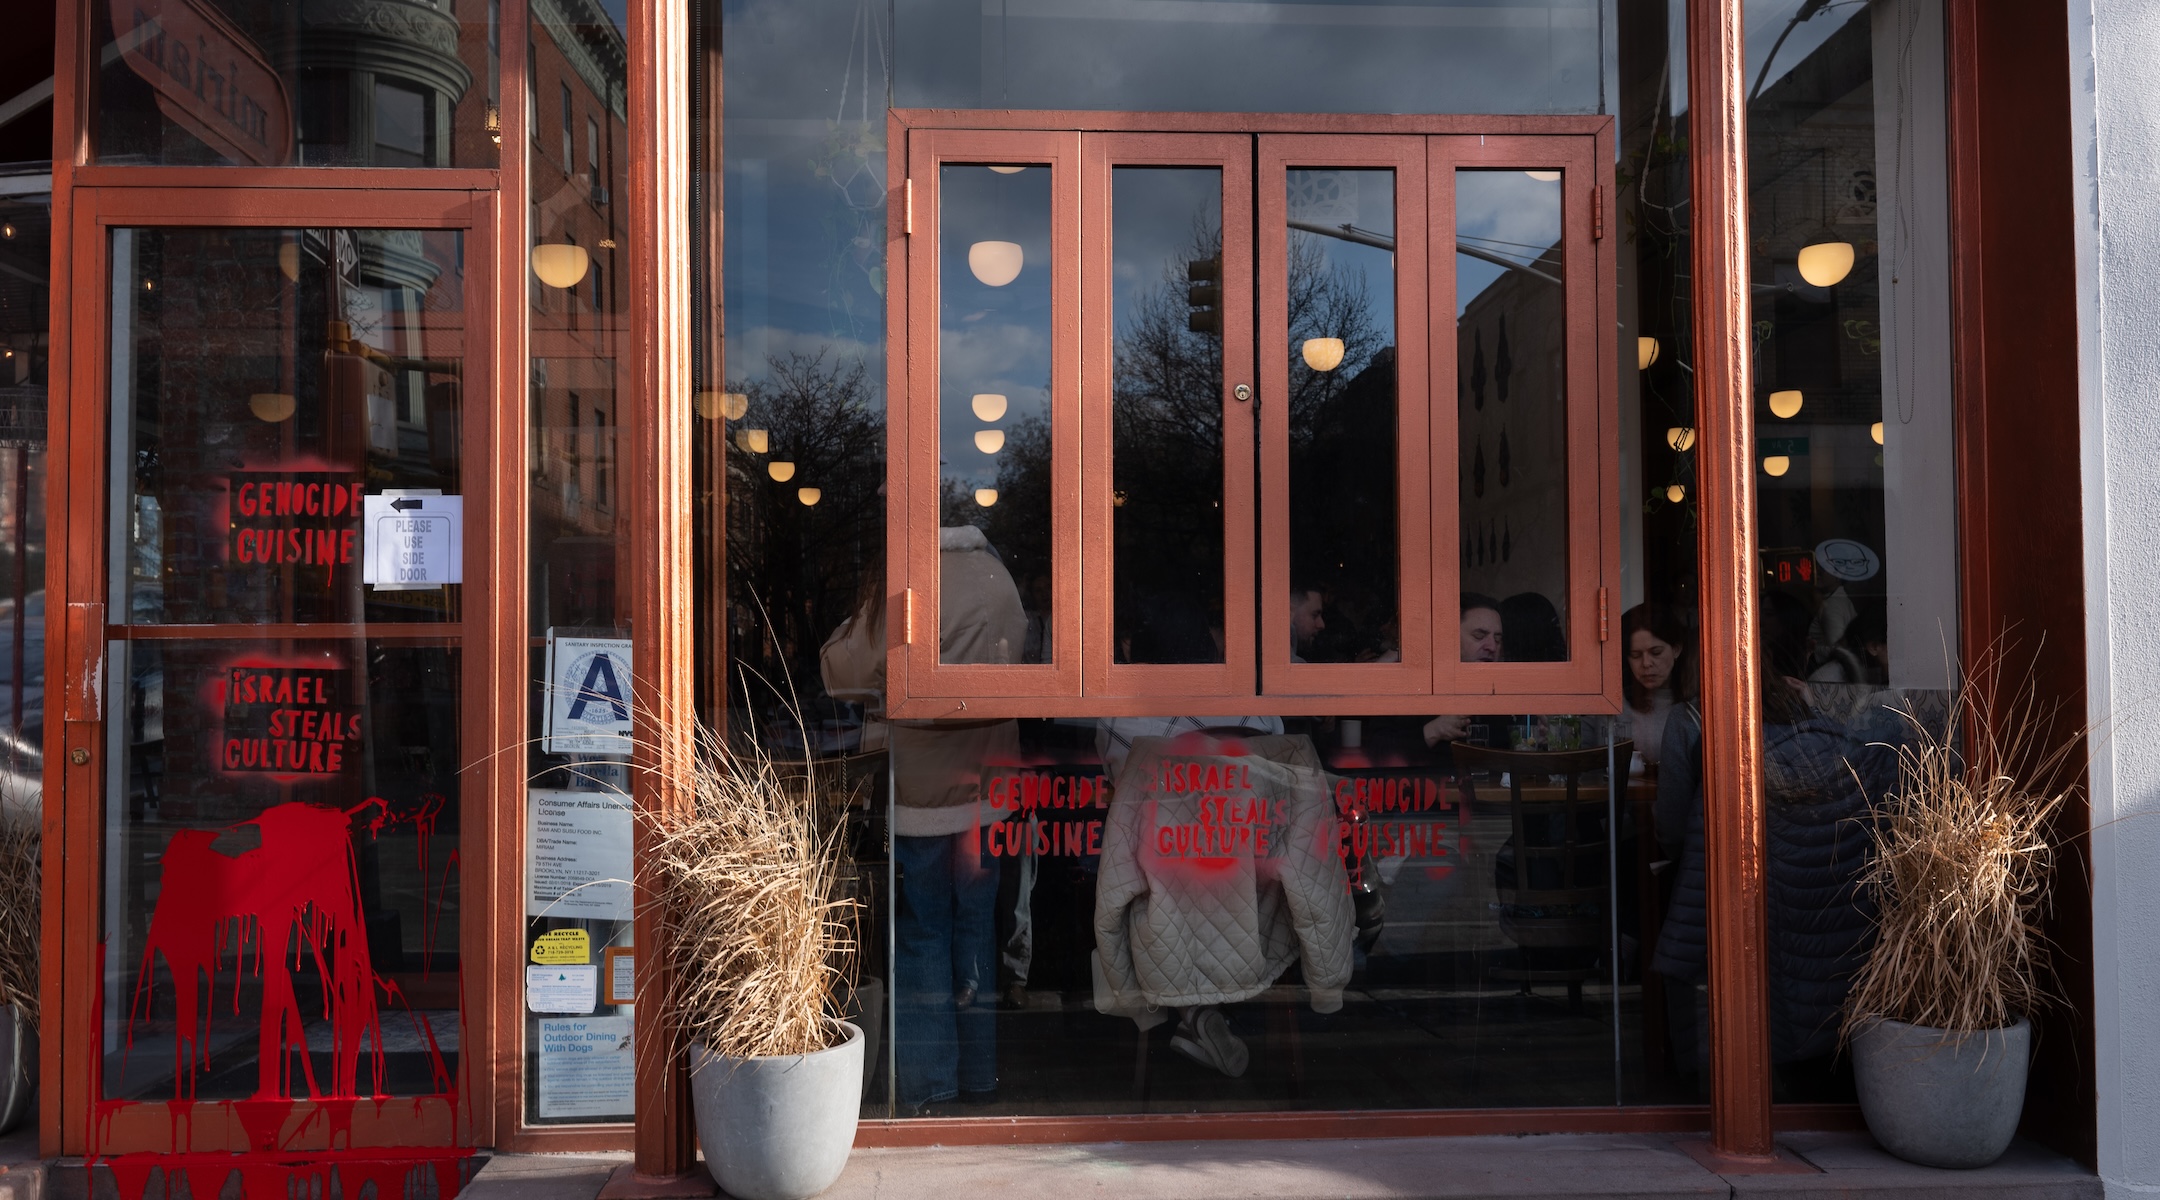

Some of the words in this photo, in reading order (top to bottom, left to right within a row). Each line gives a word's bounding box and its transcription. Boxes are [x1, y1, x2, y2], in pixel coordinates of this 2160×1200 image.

[239, 482, 364, 517] GENOCIDE
[395, 520, 432, 533] PLEASE
[237, 528, 356, 565] CUISINE
[404, 536, 423, 549] USE
[400, 567, 427, 581] DOOR
[402, 552, 425, 565] SIDE
[567, 653, 629, 721] A
[268, 709, 362, 741] STEALS
[225, 738, 343, 773] CULTURE
[538, 799, 575, 808] Consumer
[576, 801, 600, 809] Affairs
[988, 775, 1108, 810] GENOCIDE
[1335, 777, 1452, 814] GENOCIDE
[538, 808, 566, 817] License
[1200, 794, 1288, 826] STEALS
[988, 820, 1102, 857] CUISINE
[1158, 824, 1270, 855] CULTURE
[1337, 822, 1447, 858] CUISINE
[544, 1023, 571, 1032] Rules
[573, 1023, 587, 1031] for
[544, 1033, 584, 1042] Outdoor
[586, 1032, 617, 1042] Dining
[544, 1044, 566, 1053] With
[568, 1044, 593, 1054] Dogs
